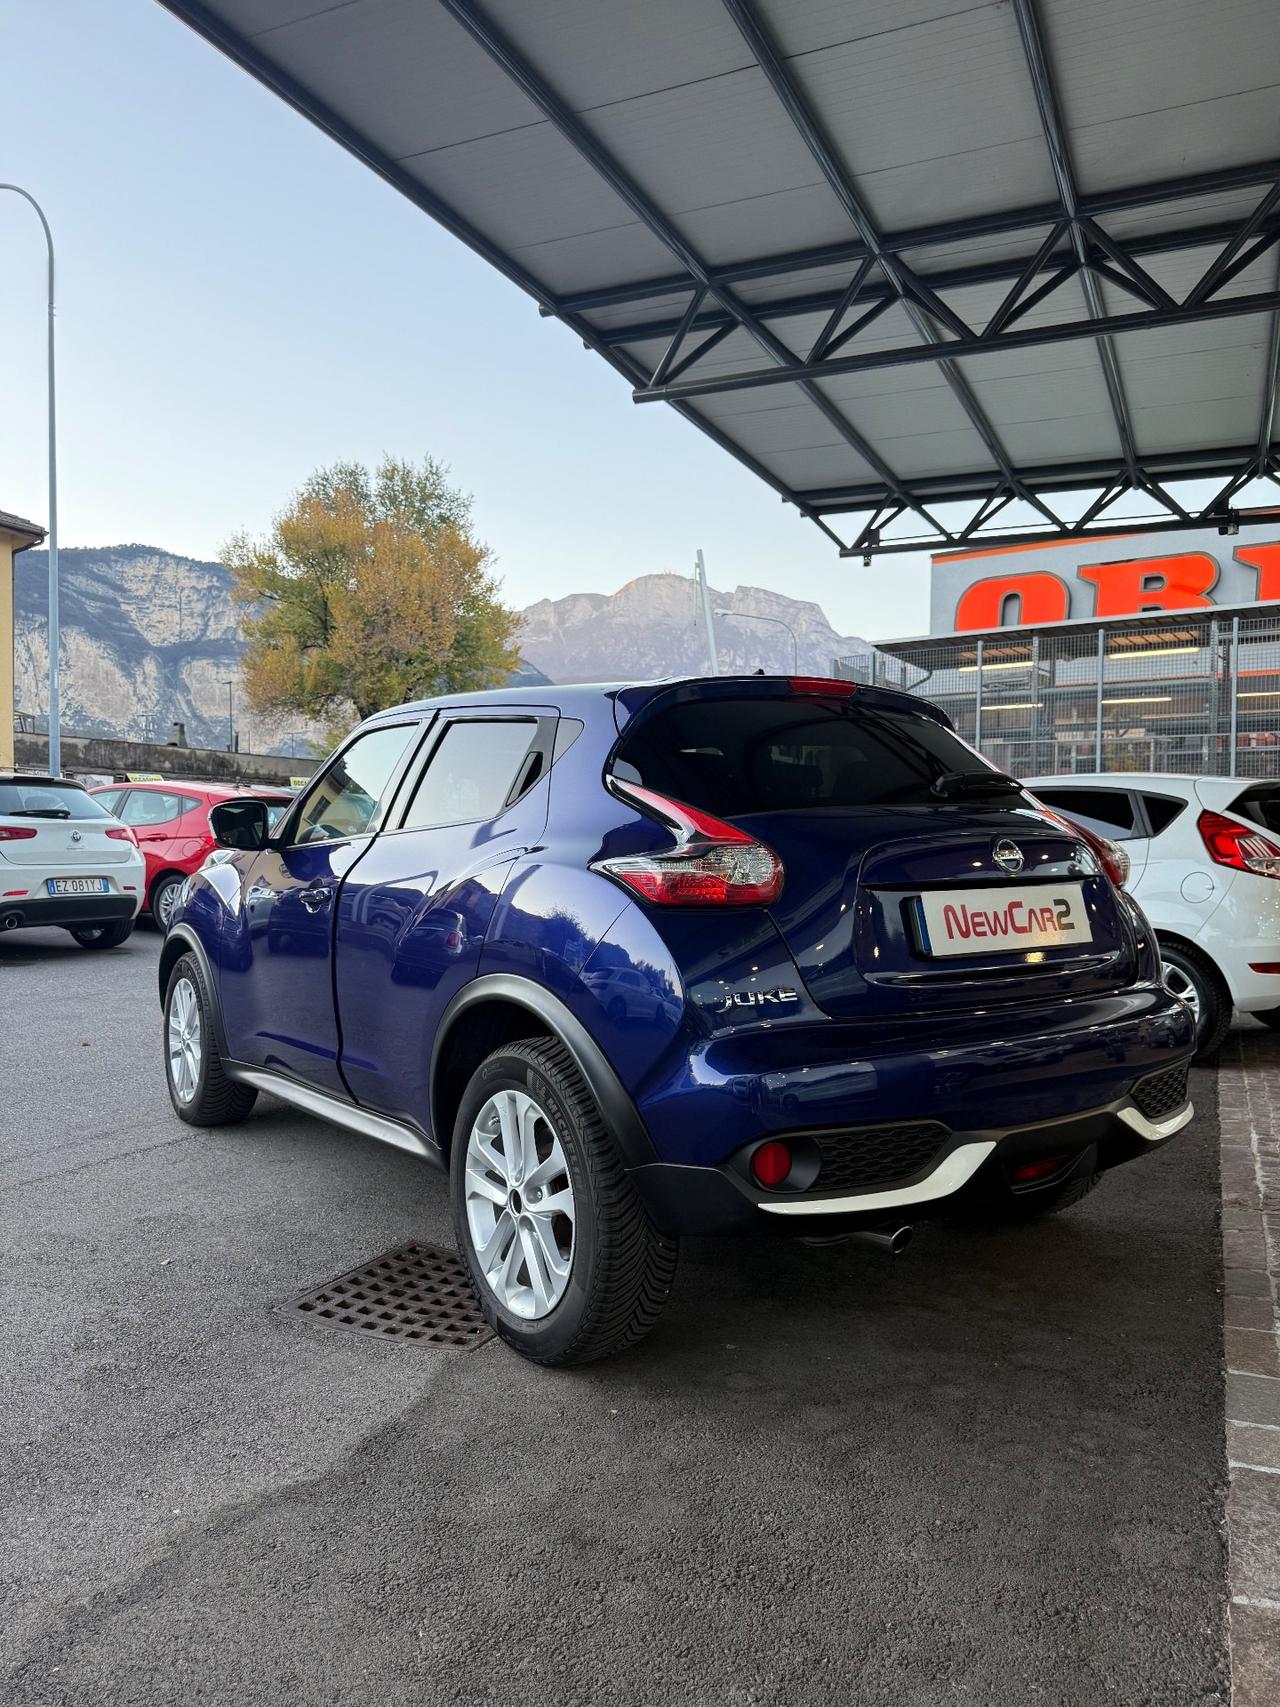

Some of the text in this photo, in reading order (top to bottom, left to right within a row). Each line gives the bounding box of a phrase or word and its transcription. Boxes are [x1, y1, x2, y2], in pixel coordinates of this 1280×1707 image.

[56, 879, 102, 892] EZ 081YJ
[715, 986, 798, 1013] JUKE
